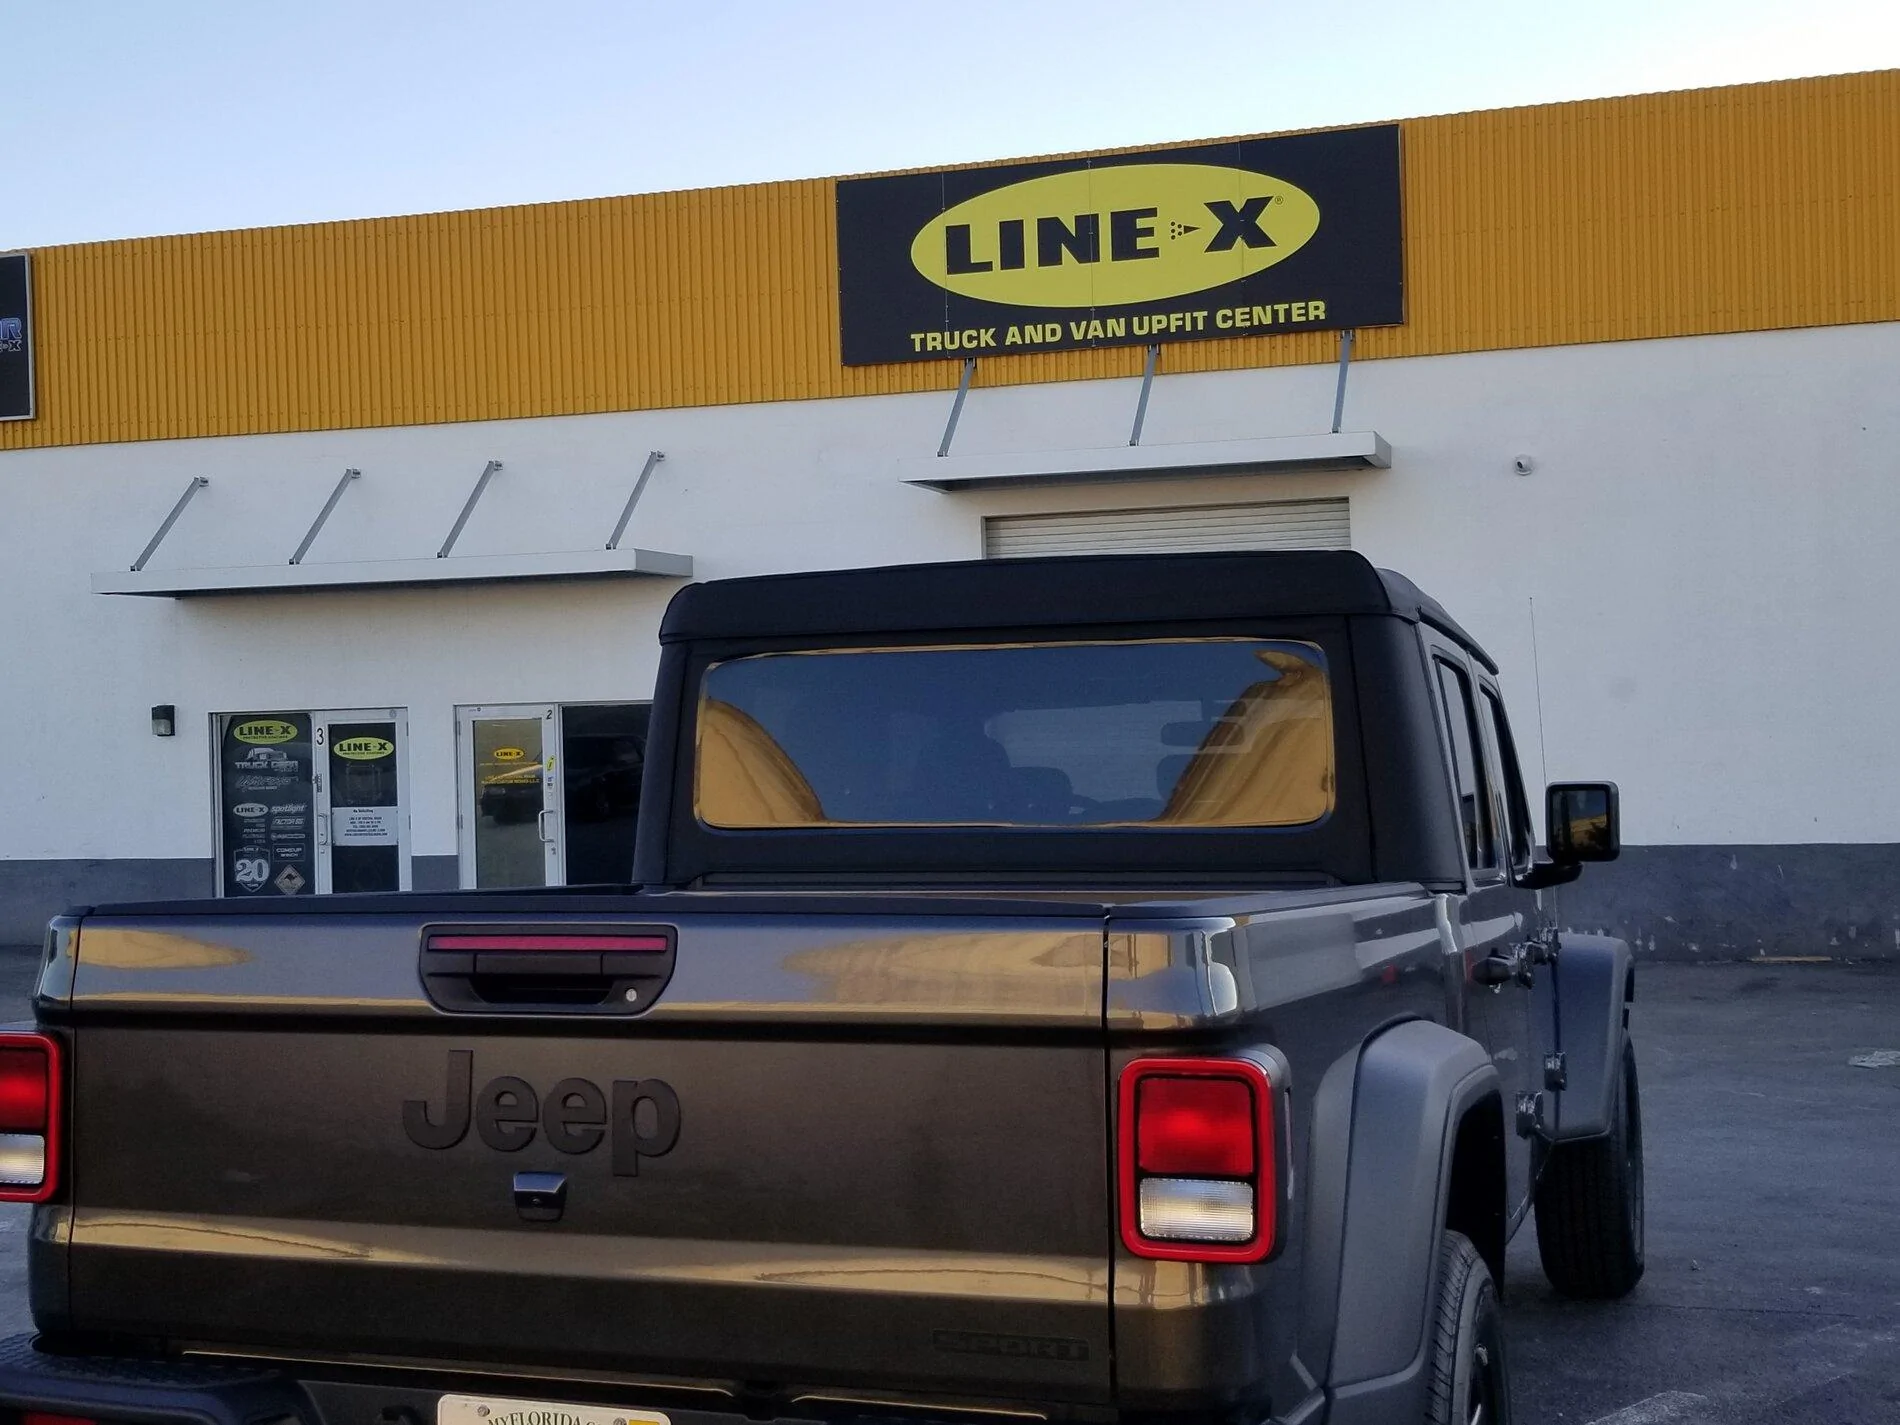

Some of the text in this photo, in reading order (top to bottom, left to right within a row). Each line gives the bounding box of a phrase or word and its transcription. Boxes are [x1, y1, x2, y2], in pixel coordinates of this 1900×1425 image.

[910, 300, 1327, 353] TRUCK AND VAN UPFIT CENTER
[545, 709, 553, 720] 2
[316, 727, 324, 746] 3
[235, 858, 269, 882] 20
[402, 1049, 682, 1178] Jeep
